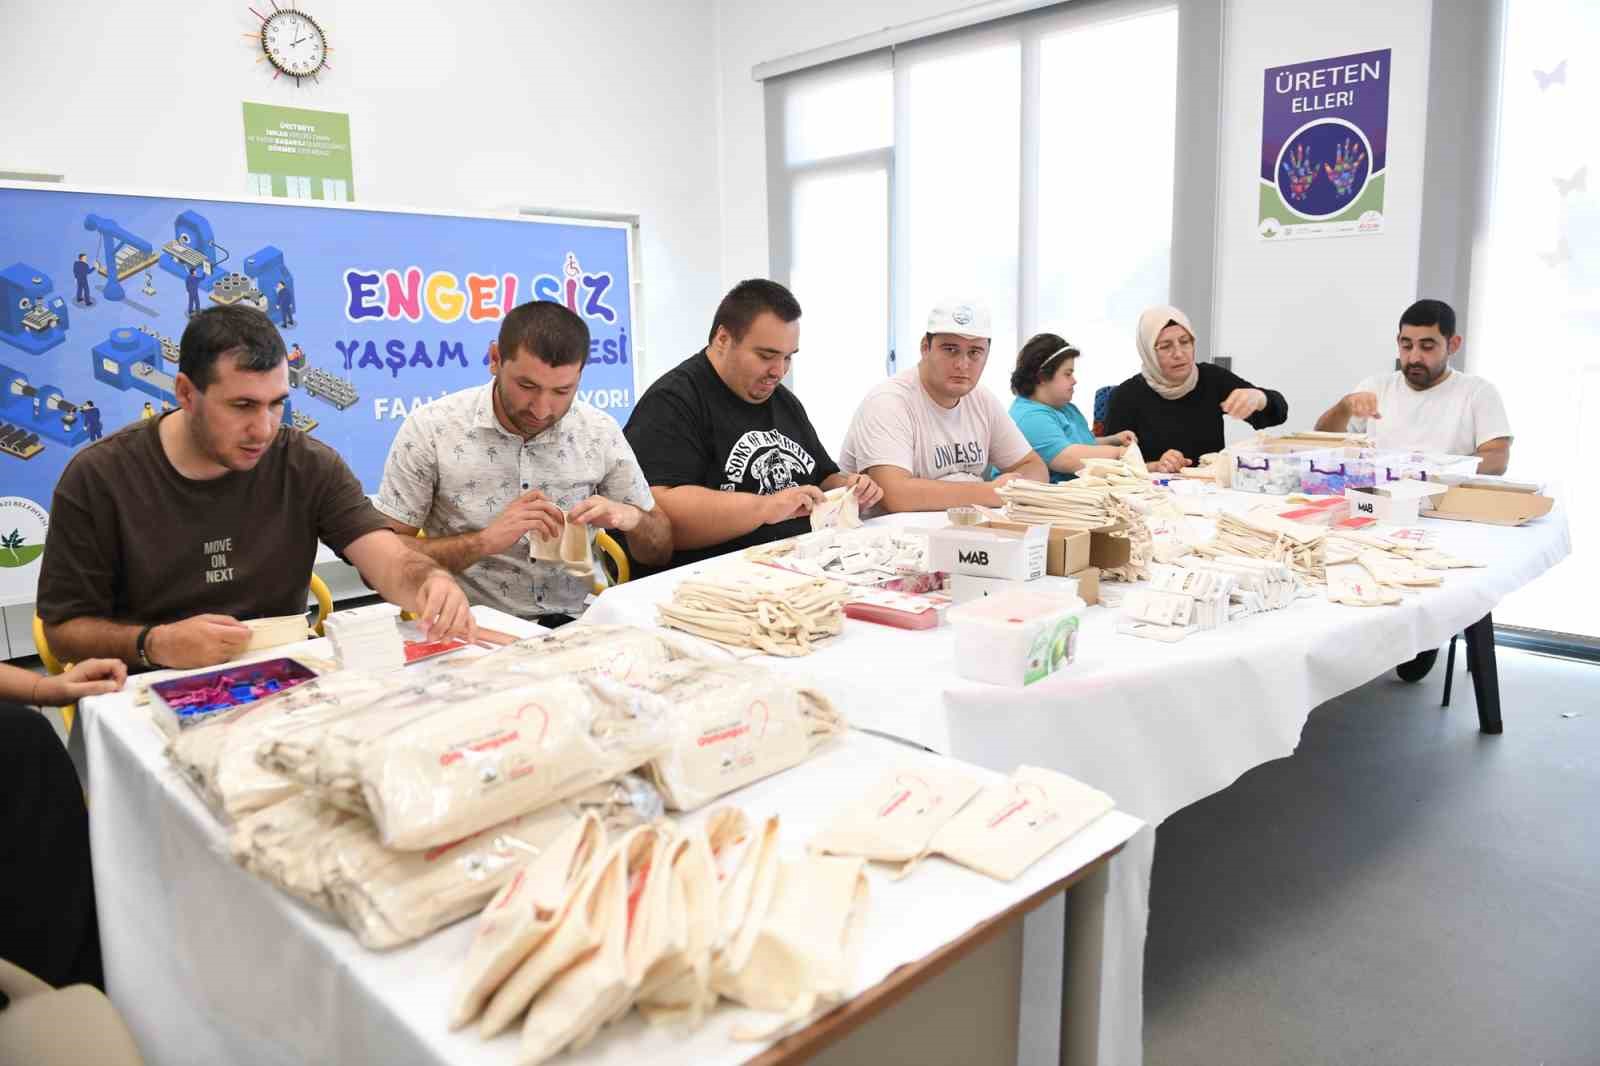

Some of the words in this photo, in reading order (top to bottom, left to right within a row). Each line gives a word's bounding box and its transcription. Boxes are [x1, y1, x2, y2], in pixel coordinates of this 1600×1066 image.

[1275, 60, 1381, 94] ÜRETEN
[1292, 90, 1354, 113] ELLER!
[335, 338, 469, 378] YAŞAM
[727, 442, 752, 478] SONS
[747, 431, 762, 448] OF
[204, 538, 232, 555] MOVE
[211, 554, 226, 568] ON
[958, 549, 989, 566] MAB
[206, 568, 234, 583] NEXT
